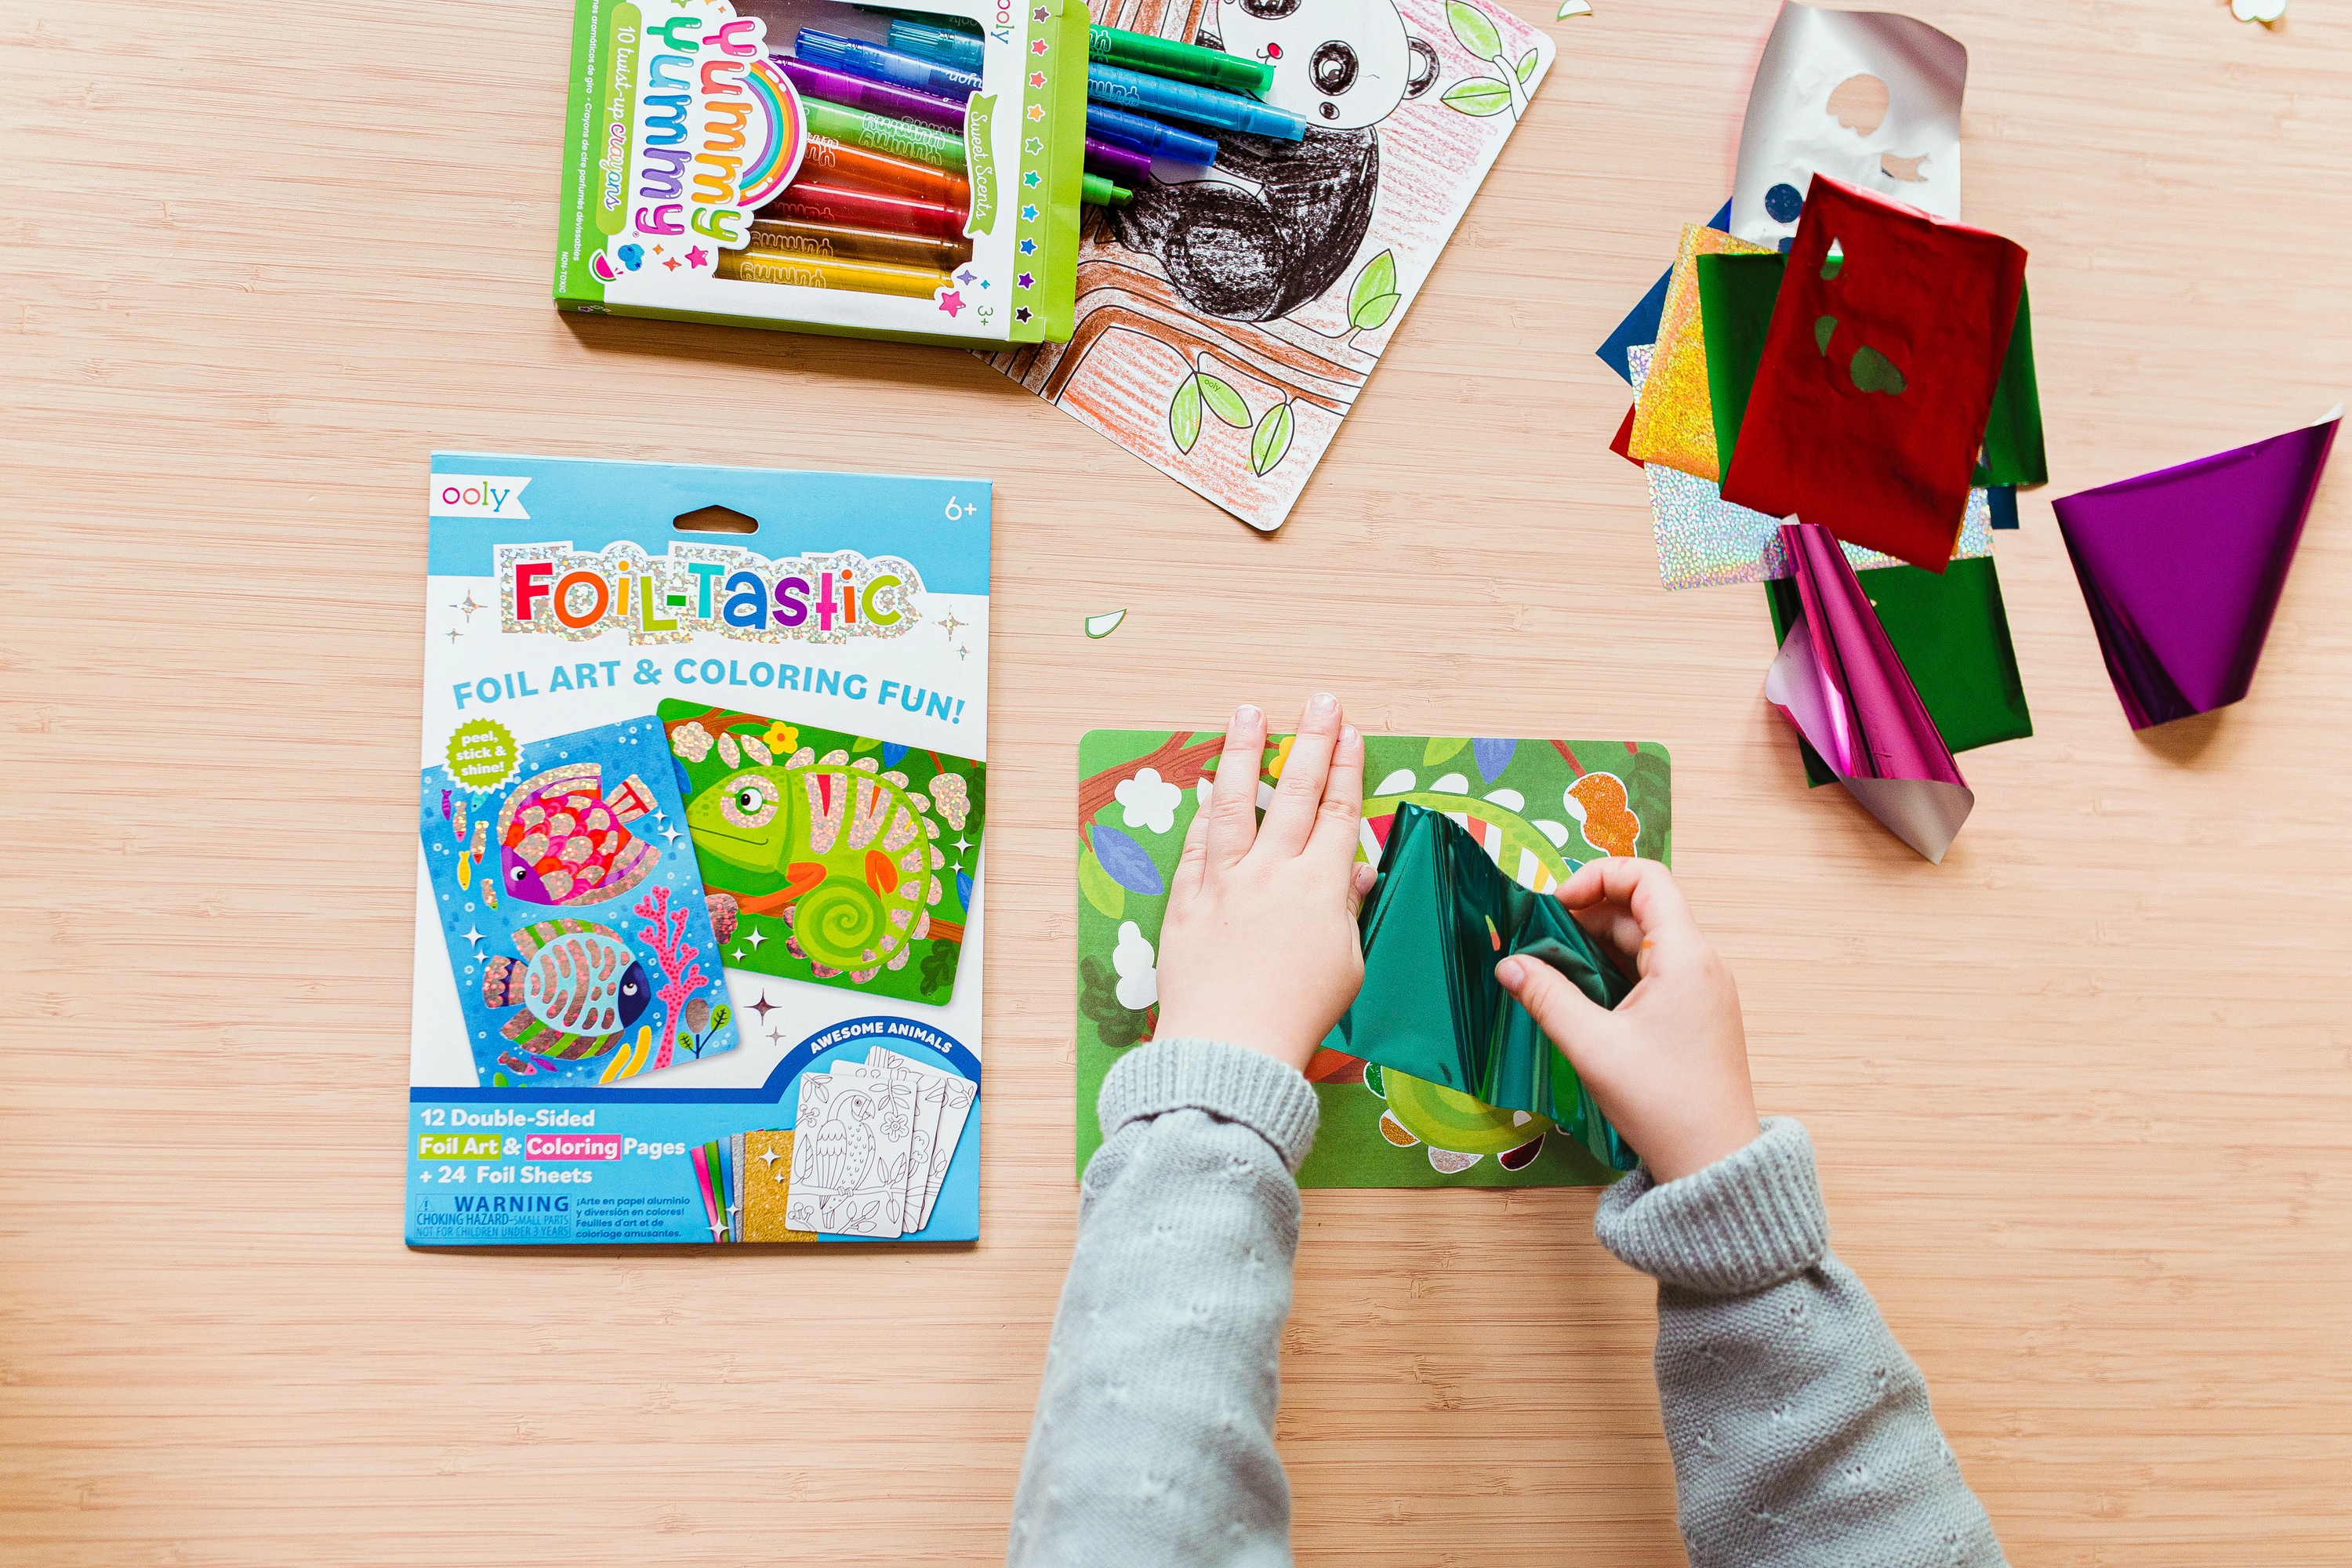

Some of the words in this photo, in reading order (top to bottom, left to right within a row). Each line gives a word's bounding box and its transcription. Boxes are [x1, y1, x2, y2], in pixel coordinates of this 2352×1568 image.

[990, 0, 1015, 45] ooly
[588, 15, 598, 64] aromáticos
[617, 26, 636, 44] 10
[587, 64, 595, 76] de
[584, 77, 594, 94] giro
[607, 47, 635, 122] twist-up
[581, 103, 592, 138] Crayons
[581, 139, 590, 151] de
[971, 111, 989, 162] Sweet
[580, 152, 589, 168] cire
[599, 122, 627, 212] crayons
[577, 169, 586, 210] parfumés
[975, 165, 993, 220] Scents
[573, 211, 584, 262] dévissables
[559, 251, 568, 293] NON-TOXIC
[978, 305, 993, 325] 3+
[1204, 379, 1221, 392] ooly
[442, 481, 510, 512] ooly
[944, 495, 977, 521] 6+
[452, 671, 539, 710] FOIL
[549, 660, 621, 692] ART
[633, 659, 662, 685] &
[673, 658, 868, 700] COLORING
[877, 680, 965, 724] FUN!
[461, 730, 498, 747] peel,
[456, 748, 492, 761] stick
[495, 746, 507, 758] &
[461, 761, 505, 776] shine!
[810, 1022, 884, 1054] AWESOME
[887, 1022, 953, 1054] ANIMALS
[420, 1108, 445, 1127] 12
[451, 1109, 595, 1127] Double-Sided
[419, 1137, 459, 1155] Foil
[463, 1137, 499, 1155] Art
[503, 1137, 522, 1156] &
[526, 1137, 618, 1160] Coloring
[623, 1137, 686, 1160] Pages
[419, 1171, 433, 1183] +
[437, 1165, 467, 1184] 24
[477, 1165, 515, 1184] Foil
[520, 1165, 593, 1184] Sheets
[454, 1196, 569, 1212] WARNING
[617, 1197, 645, 1207] papel
[647, 1196, 691, 1205] aluminio
[416, 1213, 463, 1225] CHOKING
[543, 1215, 569, 1225] PARTS
[575, 1210, 583, 1218] y
[584, 1207, 630, 1216] diversión
[416, 1226, 434, 1237] NOT
[436, 1226, 453, 1237] FOR
[456, 1226, 498, 1237] CHILDREN
[501, 1226, 530, 1237] UNDER
[533, 1227, 539, 1236] 3
[541, 1226, 569, 1237] YEARS
[575, 1229, 622, 1240] coloriage
